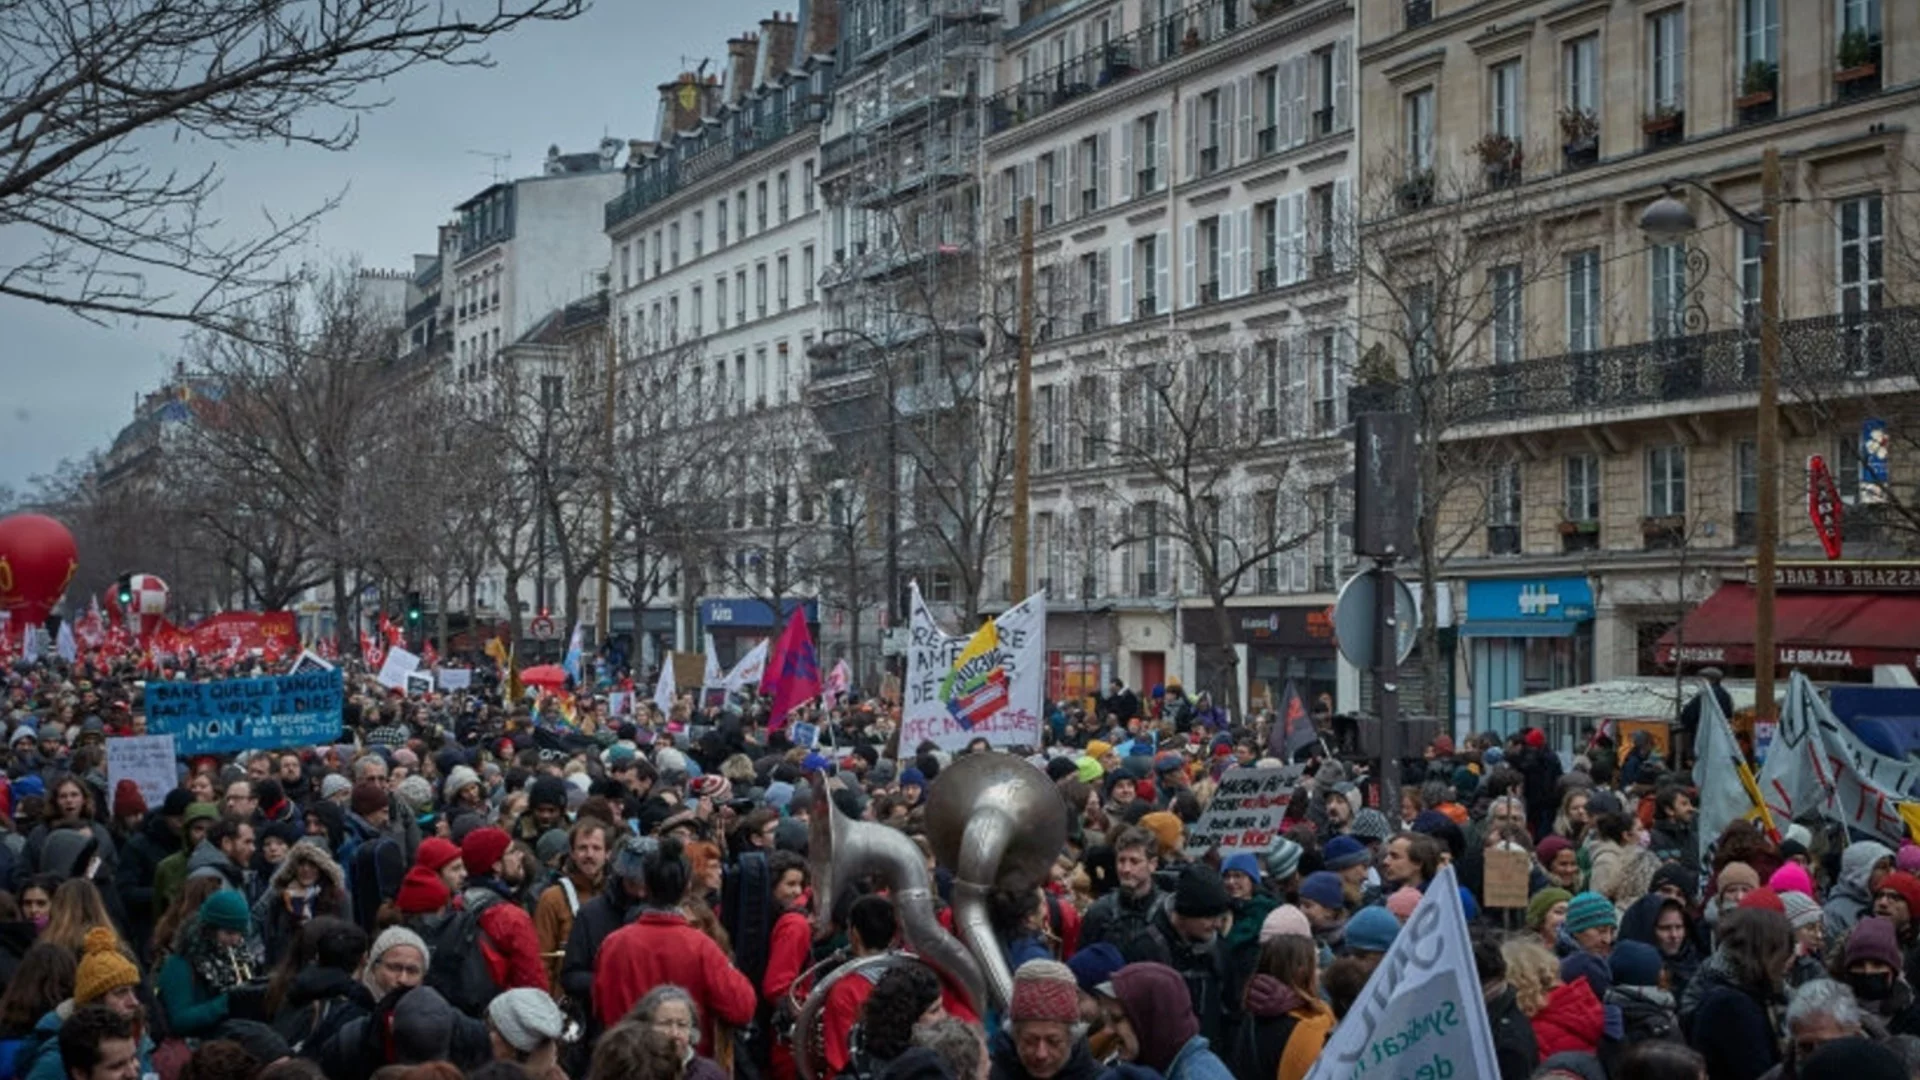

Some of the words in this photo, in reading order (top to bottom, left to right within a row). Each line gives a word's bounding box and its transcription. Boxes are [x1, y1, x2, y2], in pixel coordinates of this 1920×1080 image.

[1786, 569, 1818, 584] BAR
[1824, 570, 1844, 585] LE
[1852, 570, 1920, 586] BRAZZA
[1780, 650, 1796, 664] LE
[1797, 650, 1853, 664] BRAZZA
[210, 681, 273, 698] QUELLE
[217, 699, 264, 716] VOUS
